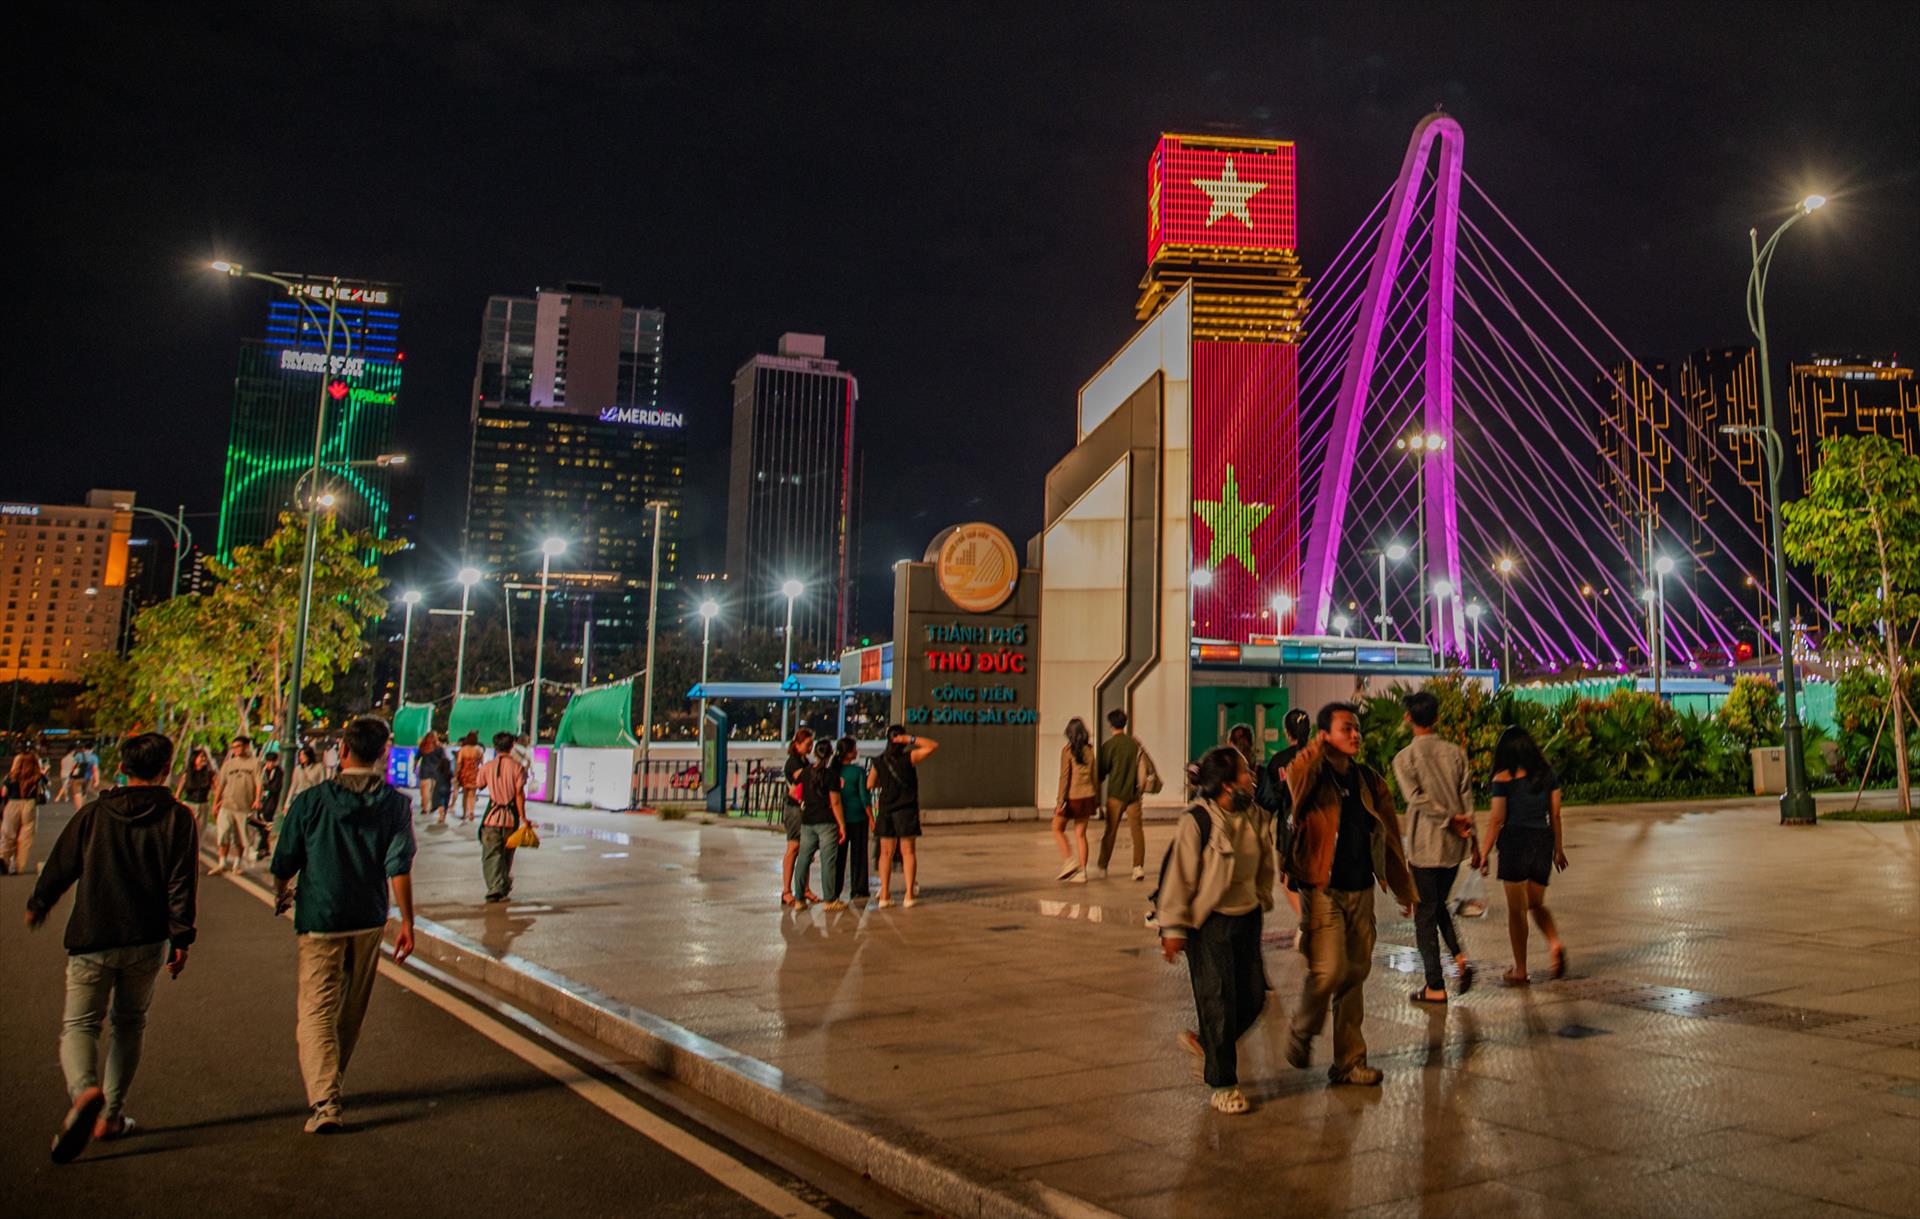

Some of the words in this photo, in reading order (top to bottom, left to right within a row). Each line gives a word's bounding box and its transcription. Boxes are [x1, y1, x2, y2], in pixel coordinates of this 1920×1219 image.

[325, 287, 387, 303] NEXUS
[618, 408, 683, 428] MERIDIEN
[977, 647, 1025, 672] ĐỨC
